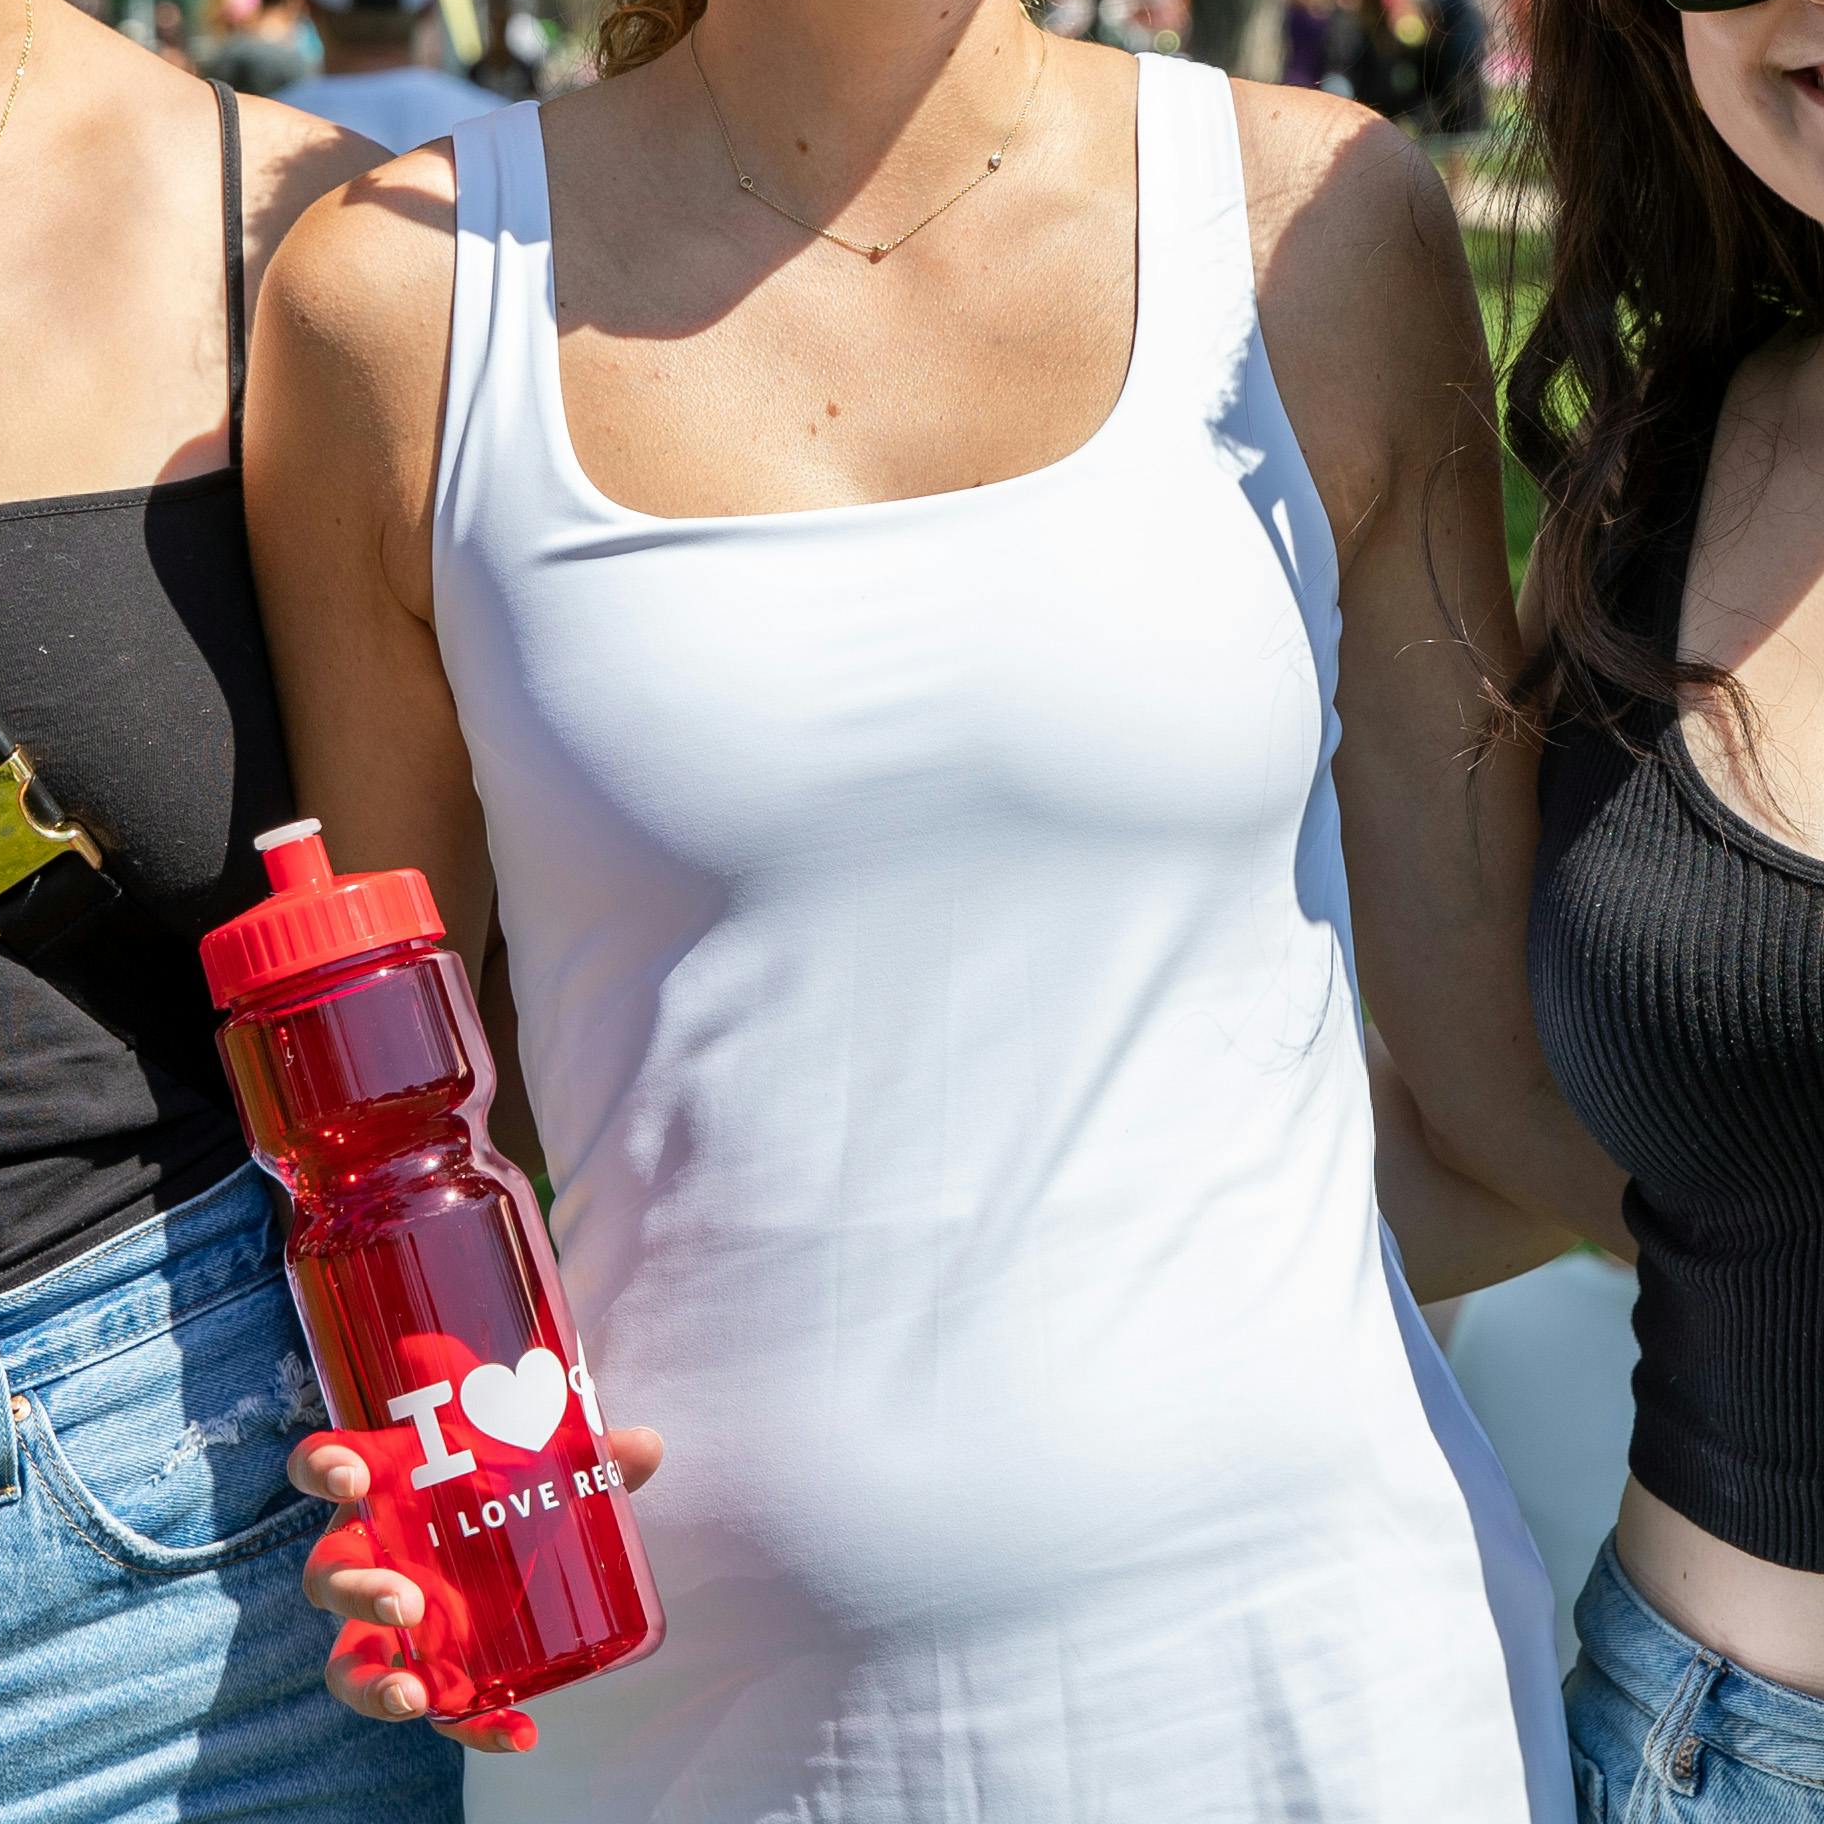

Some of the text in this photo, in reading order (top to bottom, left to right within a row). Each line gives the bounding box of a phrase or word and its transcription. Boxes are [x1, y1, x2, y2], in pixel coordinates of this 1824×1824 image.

[386, 1379, 478, 1491] I
[427, 1522, 440, 1547] I
[457, 1480, 561, 1538] LOVE
